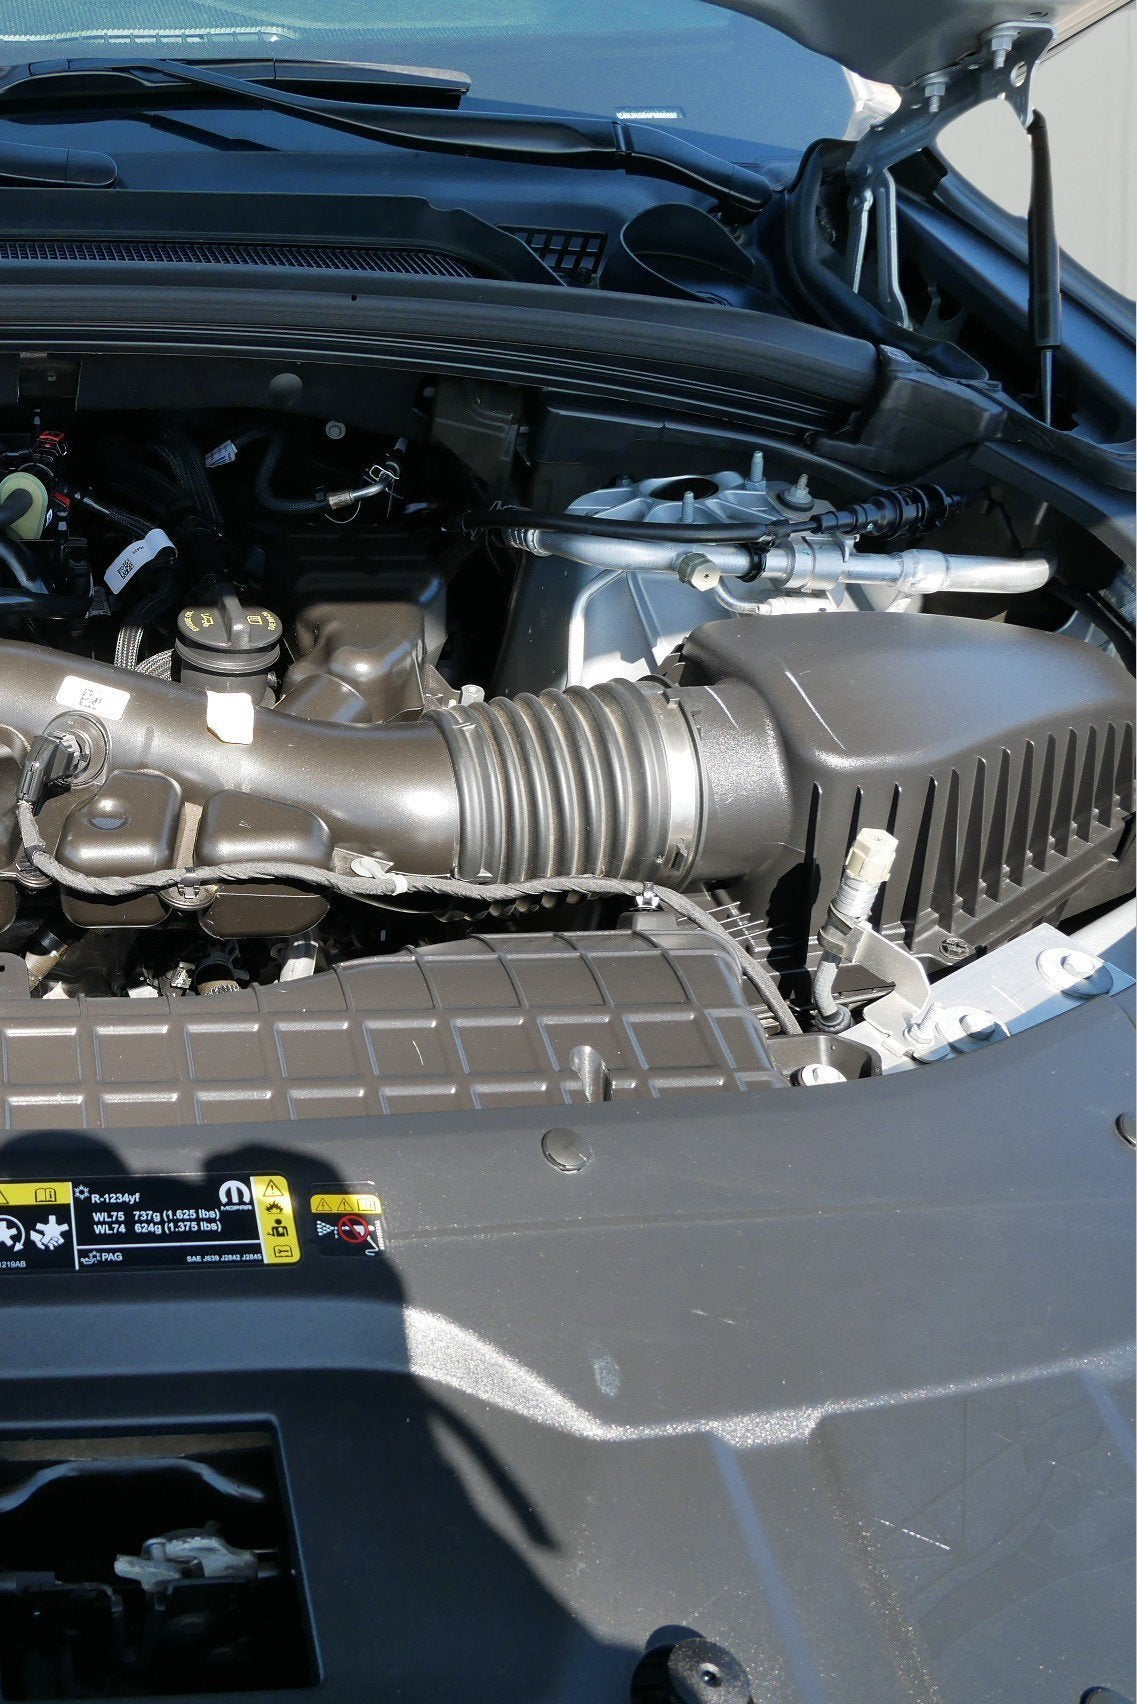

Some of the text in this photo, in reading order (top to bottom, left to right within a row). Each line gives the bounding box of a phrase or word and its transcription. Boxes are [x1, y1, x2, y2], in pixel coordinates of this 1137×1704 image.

[91, 1193, 140, 1205] R-1234yf
[220, 1204, 253, 1212] MOPAR
[92, 1208, 220, 1222] WL75 737g (1.625 lbs)
[93, 1220, 222, 1235] WL74 624g (1.375 lbs)
[101, 1252, 123, 1262] PAG
[186, 1255, 202, 1263] SAE
